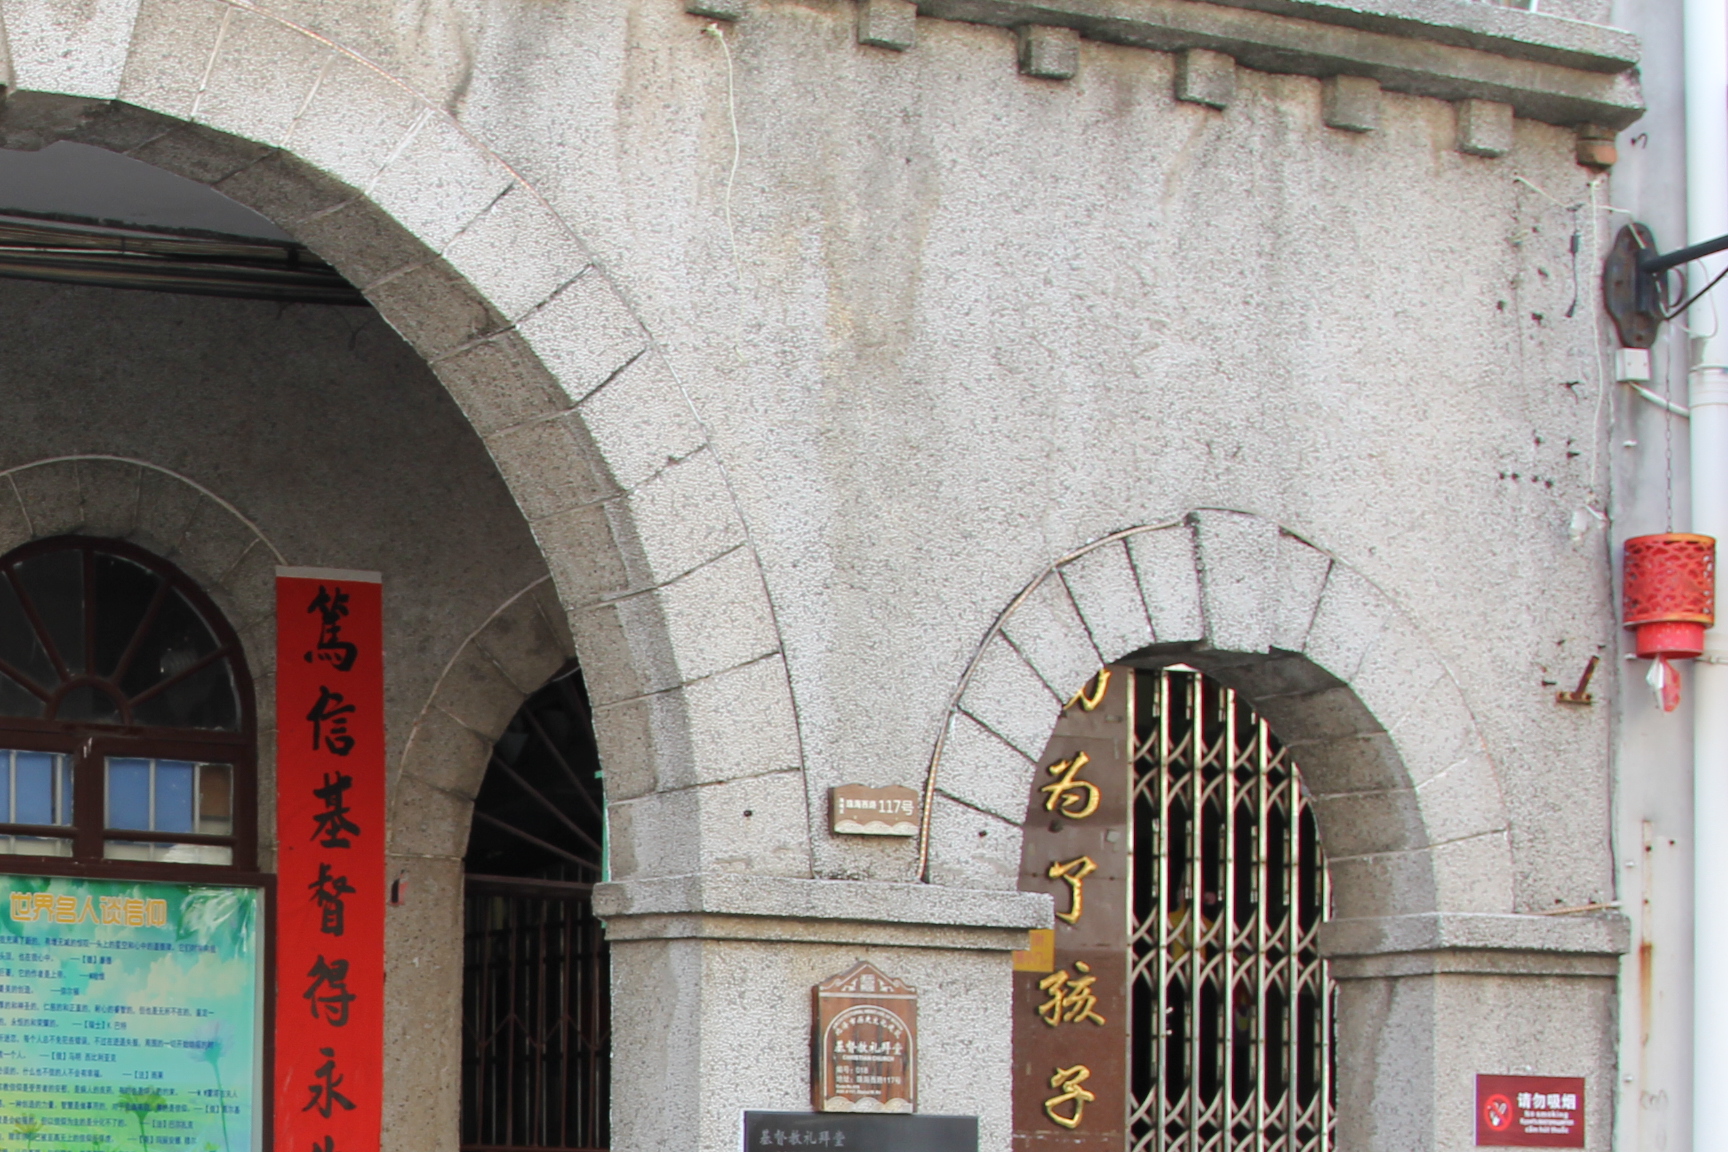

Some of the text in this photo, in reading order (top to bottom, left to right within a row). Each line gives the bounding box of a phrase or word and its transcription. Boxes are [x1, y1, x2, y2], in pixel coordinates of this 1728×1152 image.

[878, 800, 915, 817] 117号
[9, 891, 167, 927] 世界名人谈信仰
[834, 1039, 904, 1056] 基督教礼拜堂
[1517, 1091, 1577, 1110] 请勿吸烟
[759, 1128, 846, 1148] 基督教礼拜堂
